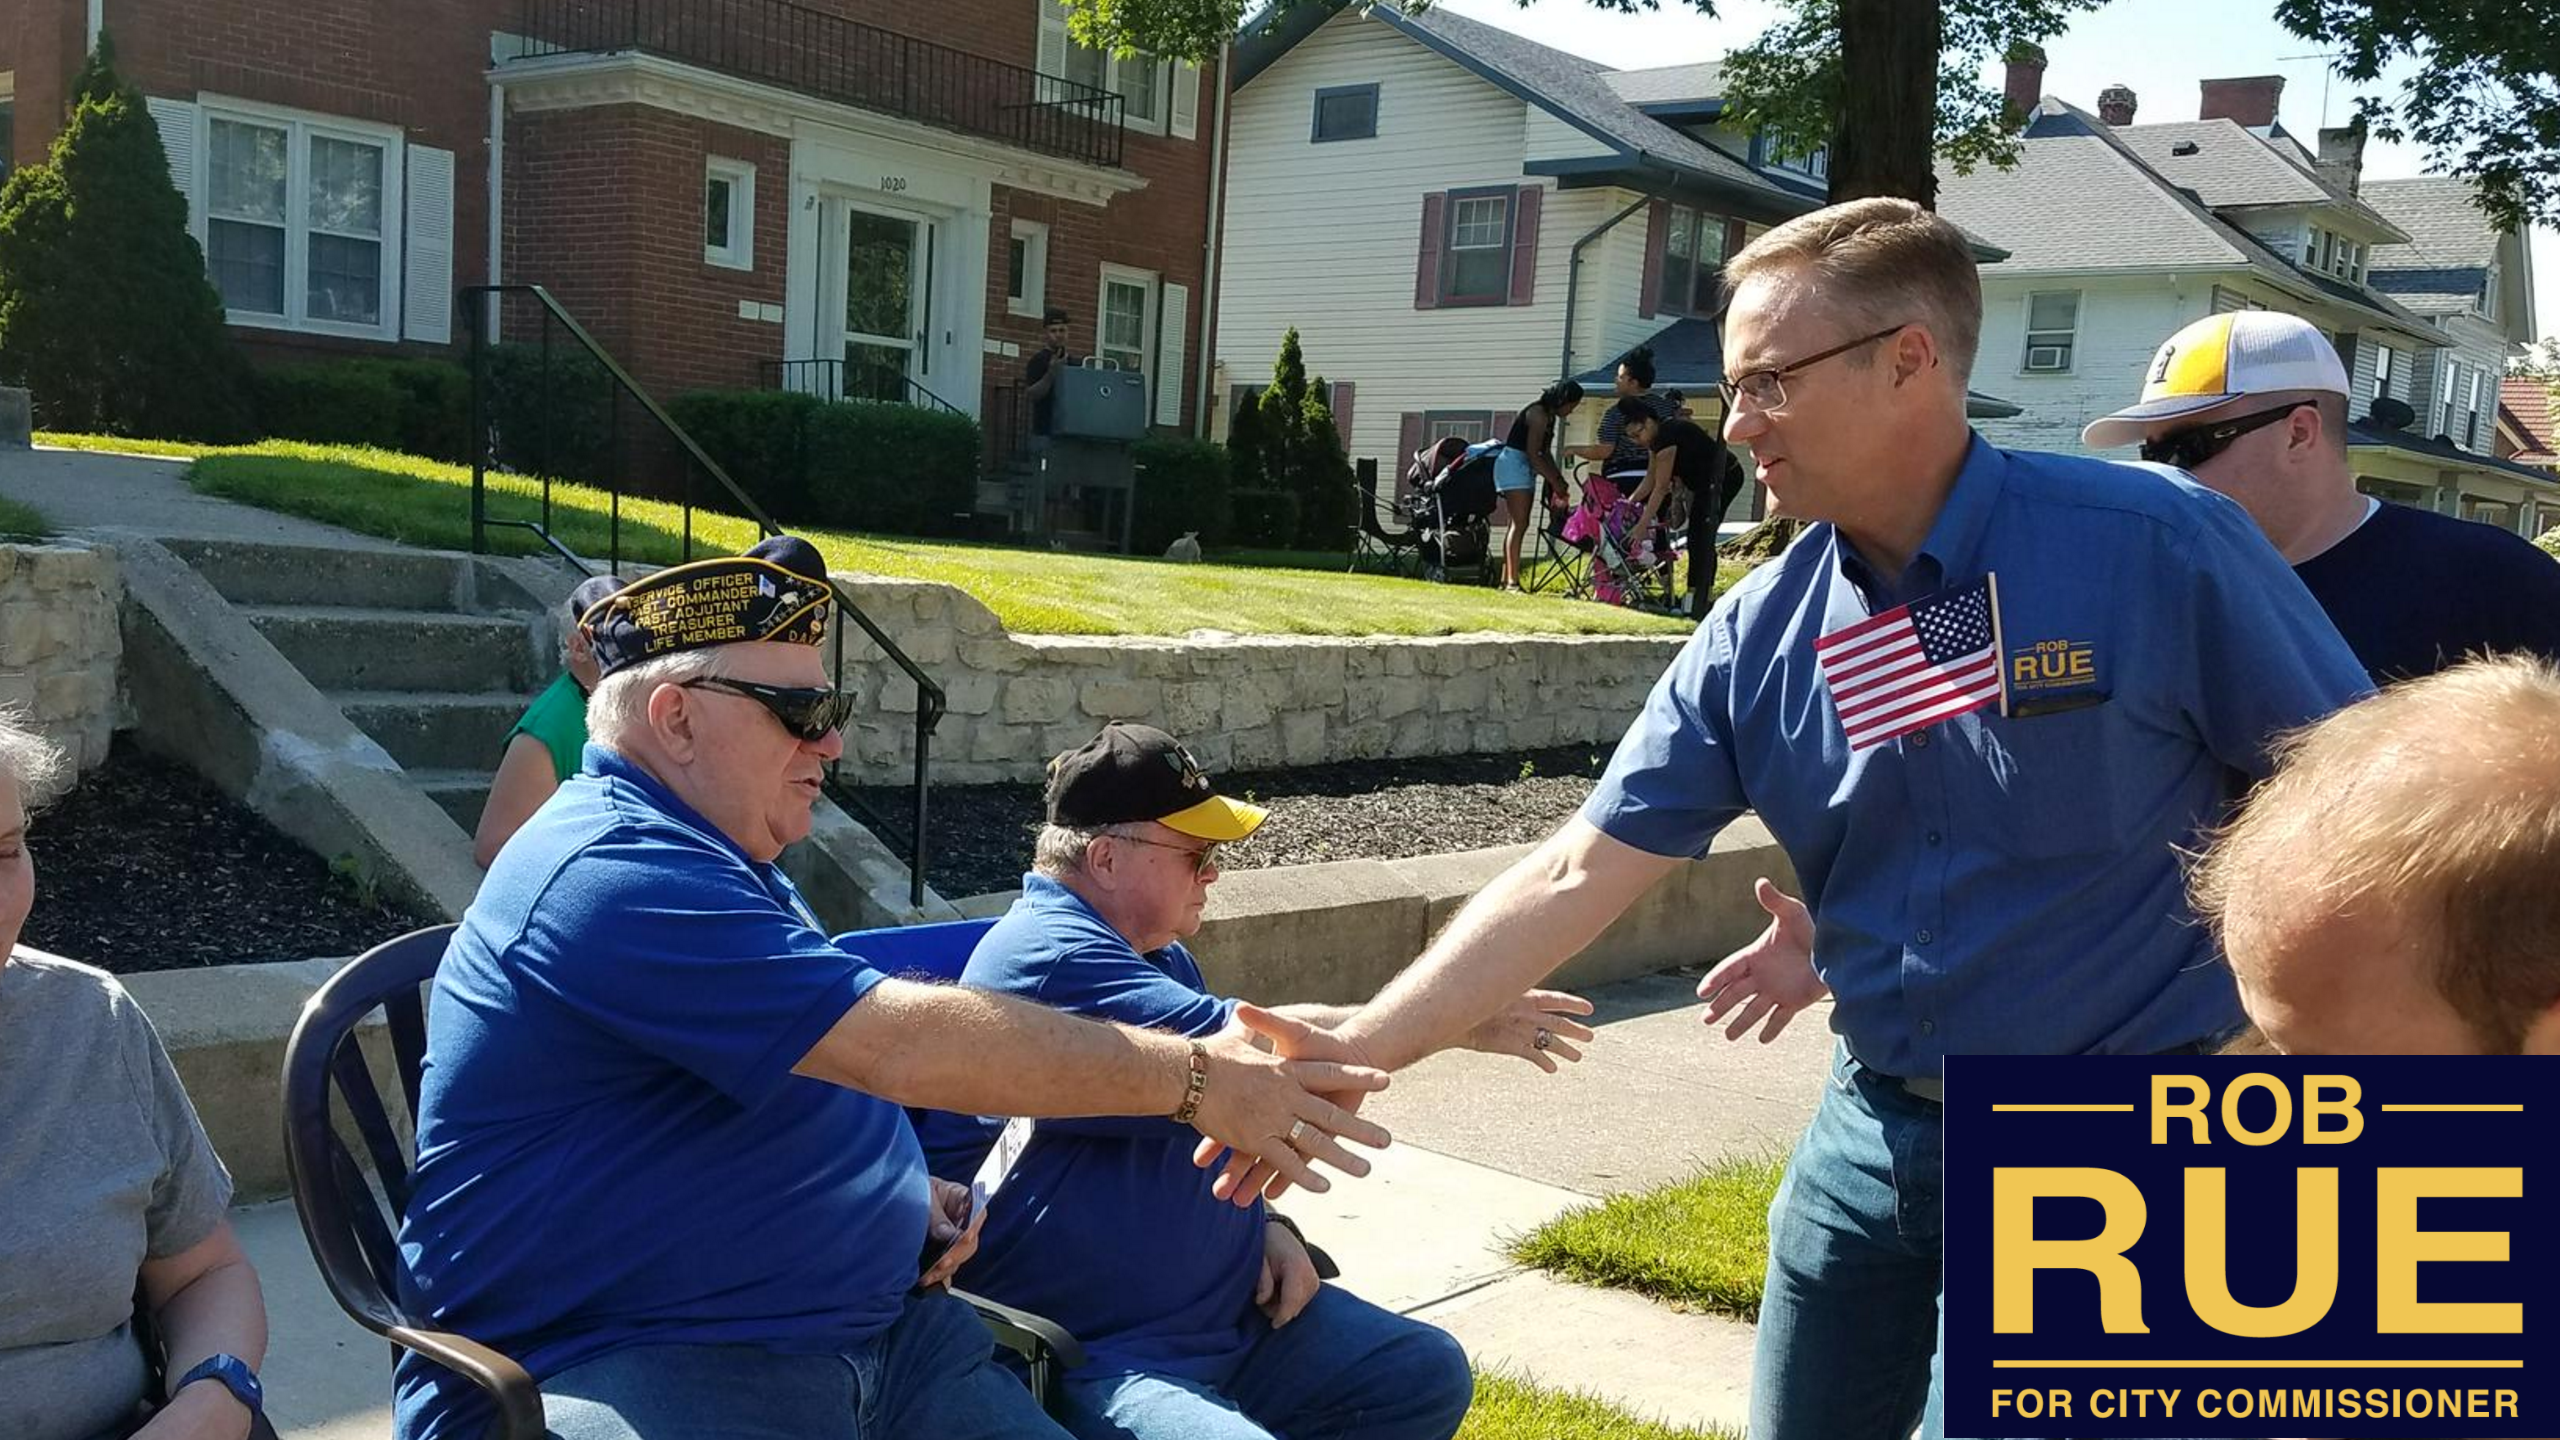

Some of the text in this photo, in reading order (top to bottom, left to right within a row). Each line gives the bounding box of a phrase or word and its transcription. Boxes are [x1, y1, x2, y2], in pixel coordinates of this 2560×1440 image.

[881, 176, 906, 191] 1020
[629, 585, 760, 620] PAST COMMANDER
[632, 572, 754, 608] SERVICE OFFICER
[635, 599, 750, 629] PAST ADJUTANT
[651, 613, 735, 637] TREASURER
[644, 625, 746, 653] LIFE MEMBER
[2036, 640, 2069, 653] ROB
[2014, 650, 2094, 681] RUE
